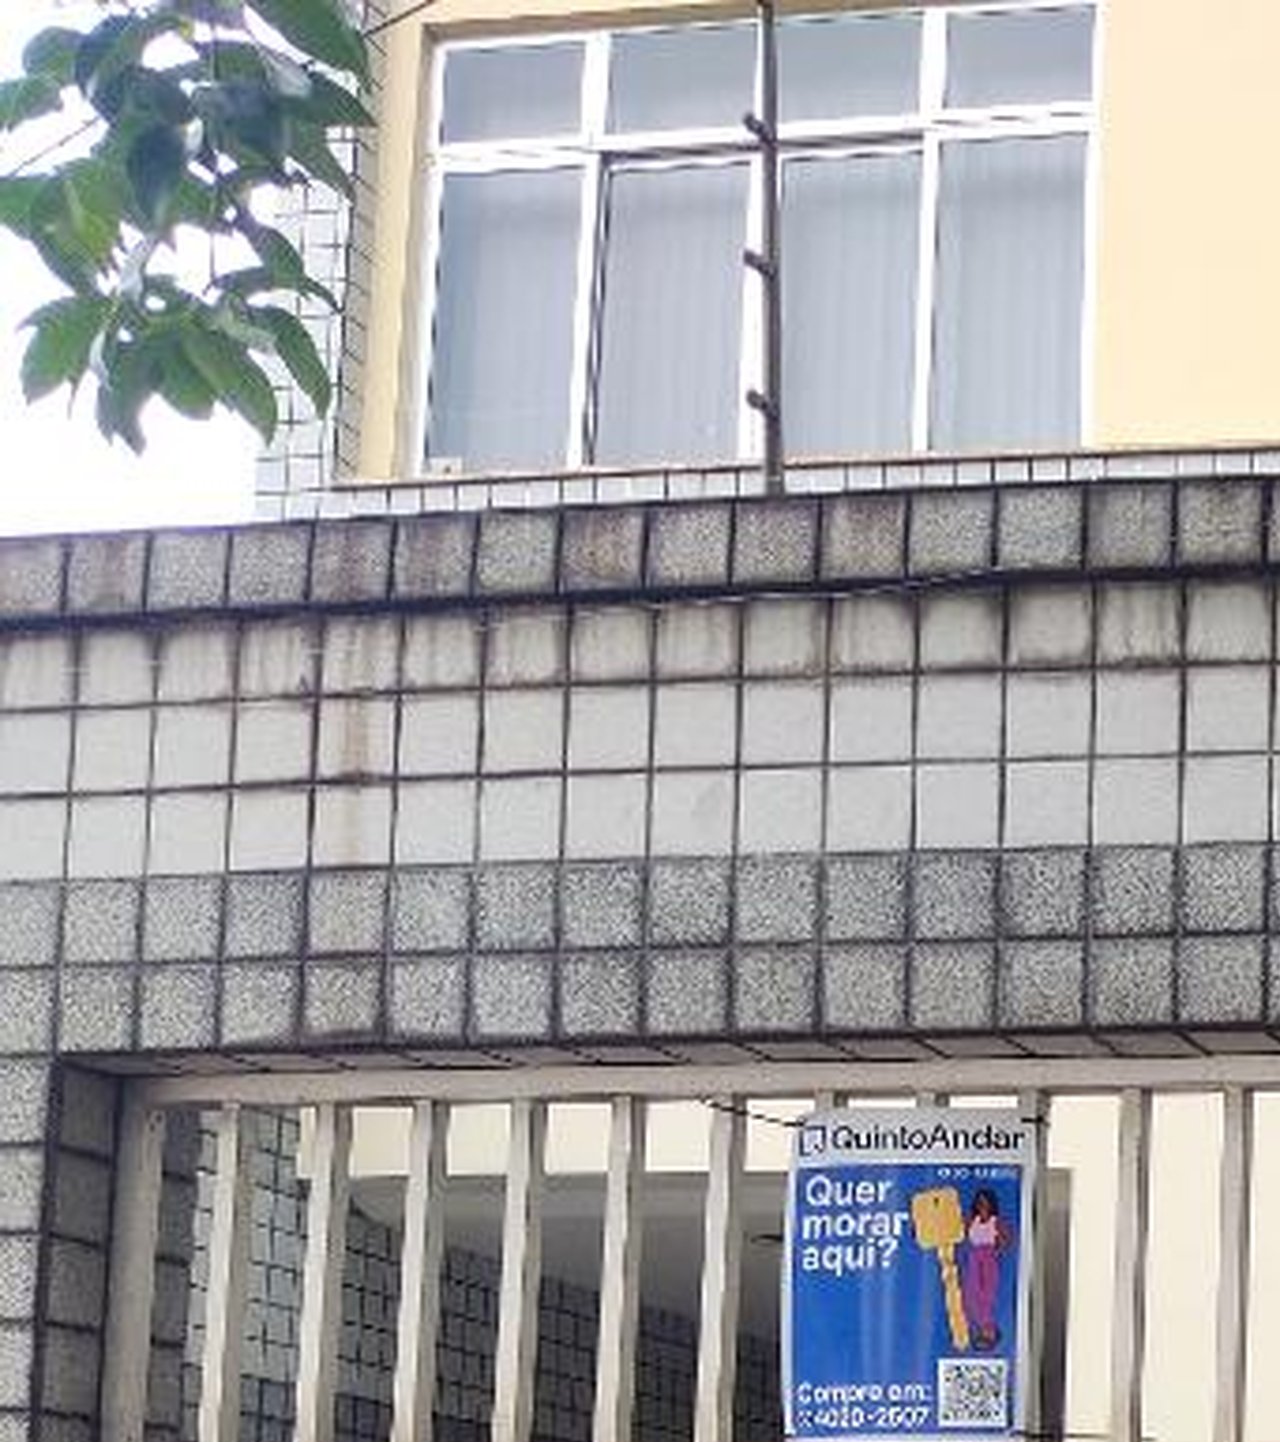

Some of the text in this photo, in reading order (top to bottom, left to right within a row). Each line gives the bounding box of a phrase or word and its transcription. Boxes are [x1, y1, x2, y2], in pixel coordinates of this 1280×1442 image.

[831, 1125, 1026, 1151] QuintoAndar
[805, 1175, 893, 1207] Quer
[802, 1211, 909, 1240] morar
[801, 1237, 899, 1276] aqui?
